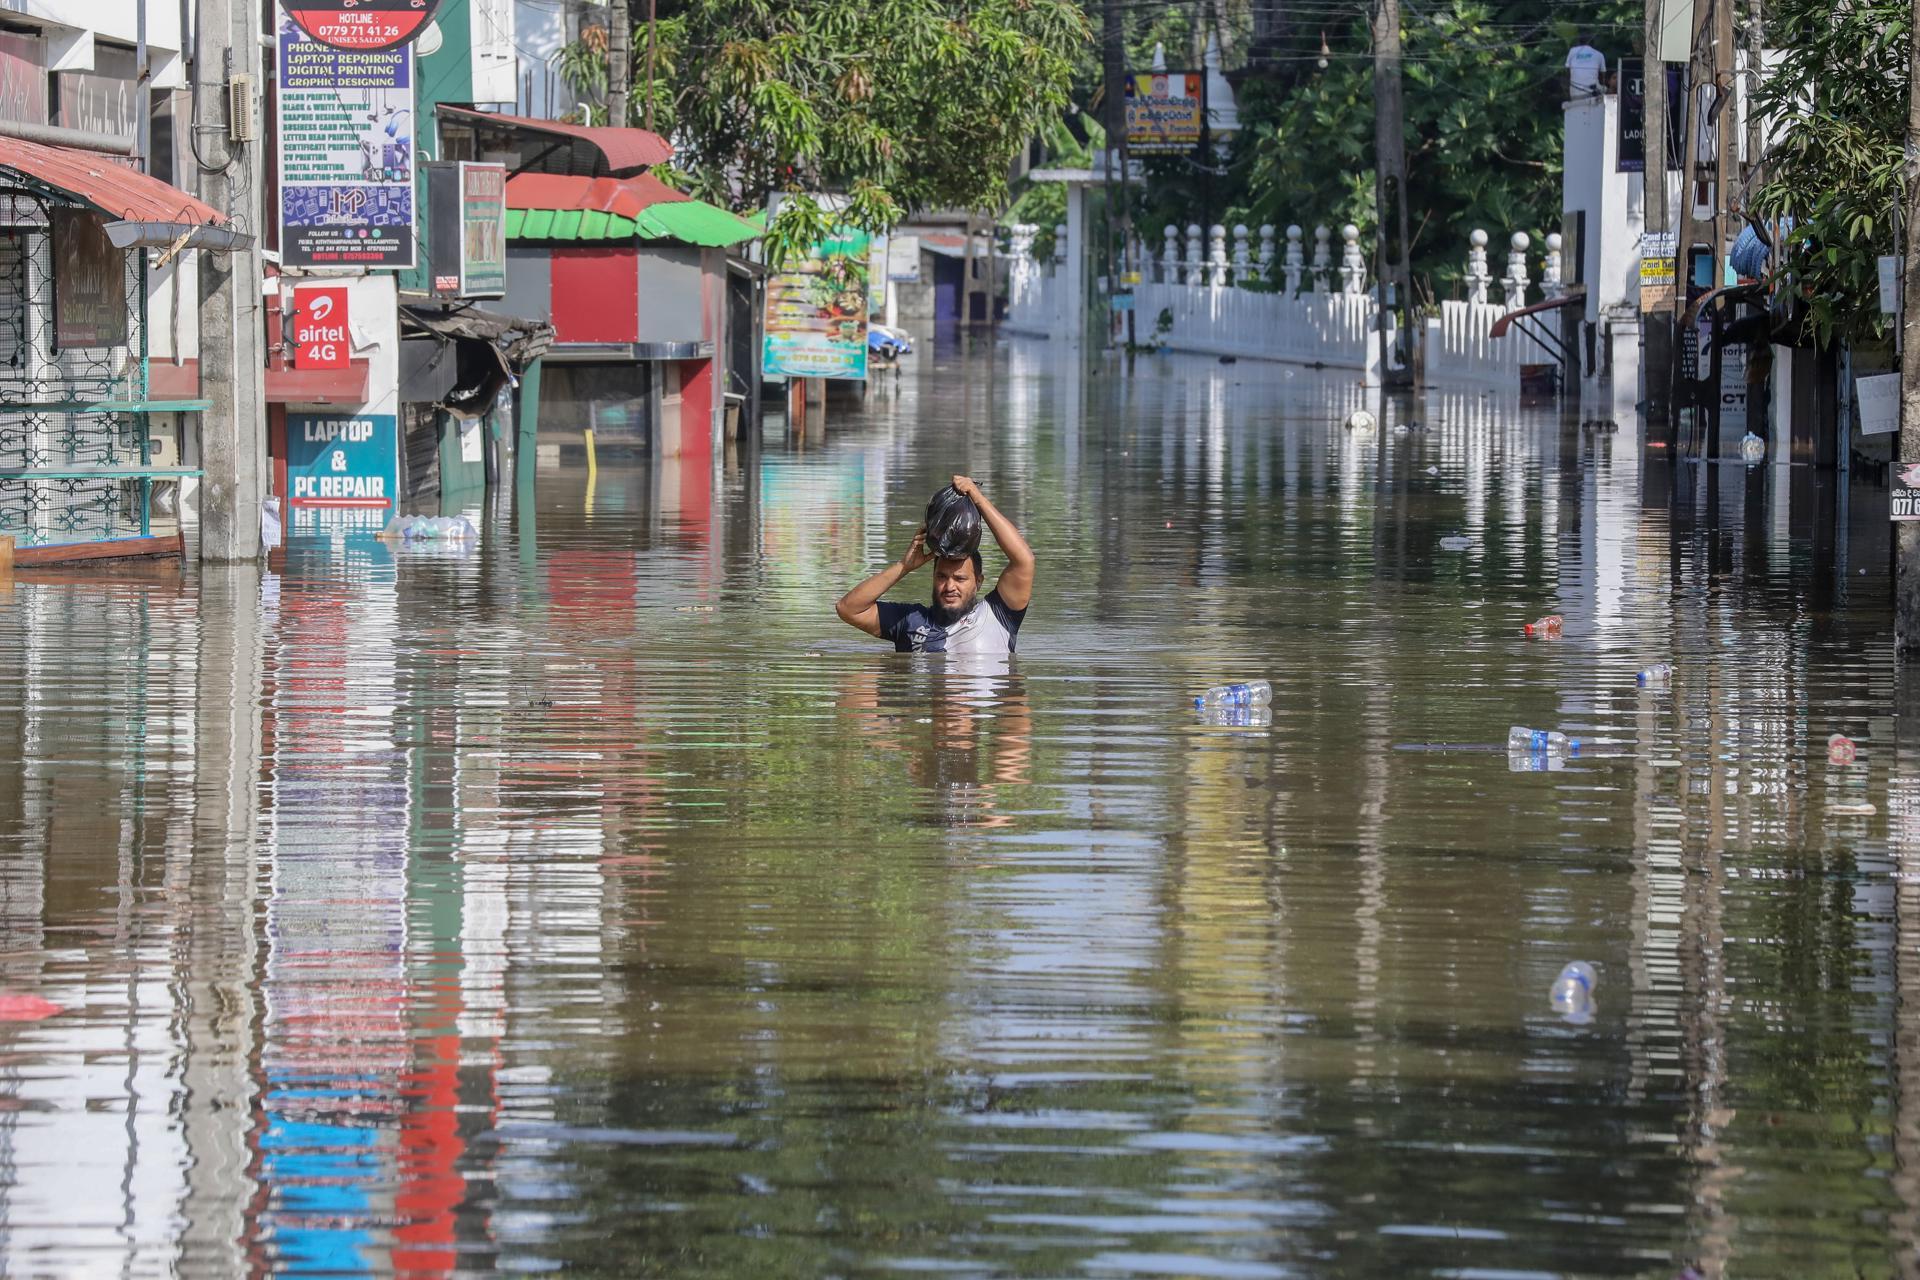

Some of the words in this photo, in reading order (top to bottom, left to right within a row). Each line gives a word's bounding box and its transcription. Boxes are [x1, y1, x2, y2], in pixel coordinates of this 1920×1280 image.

[339, 13, 373, 24] HOTLINE
[319, 26, 348, 36] 0779
[351, 26, 364, 36] 71
[367, 26, 381, 36] 41
[384, 26, 399, 36] 26
[328, 36, 358, 44] UNISEX
[360, 36, 387, 44] SALON
[288, 43, 329, 52] PHONE
[288, 54, 335, 64] LAPTOP
[338, 54, 403, 64] REPAIRING
[288, 65, 335, 75] DIGITAL
[338, 65, 395, 75] PRINTING
[288, 77, 335, 87] GRAPHIC
[338, 77, 395, 87] DESIGNING
[312, 252, 339, 261] HOTLINE
[299, 325, 345, 342] airtel
[308, 345, 336, 361] 4G
[305, 420, 373, 442] LAPTOP
[331, 450, 347, 471] &
[295, 476, 316, 497] PC
[320, 476, 384, 497] REPAIR
[1892, 498, 1912, 515] 077
